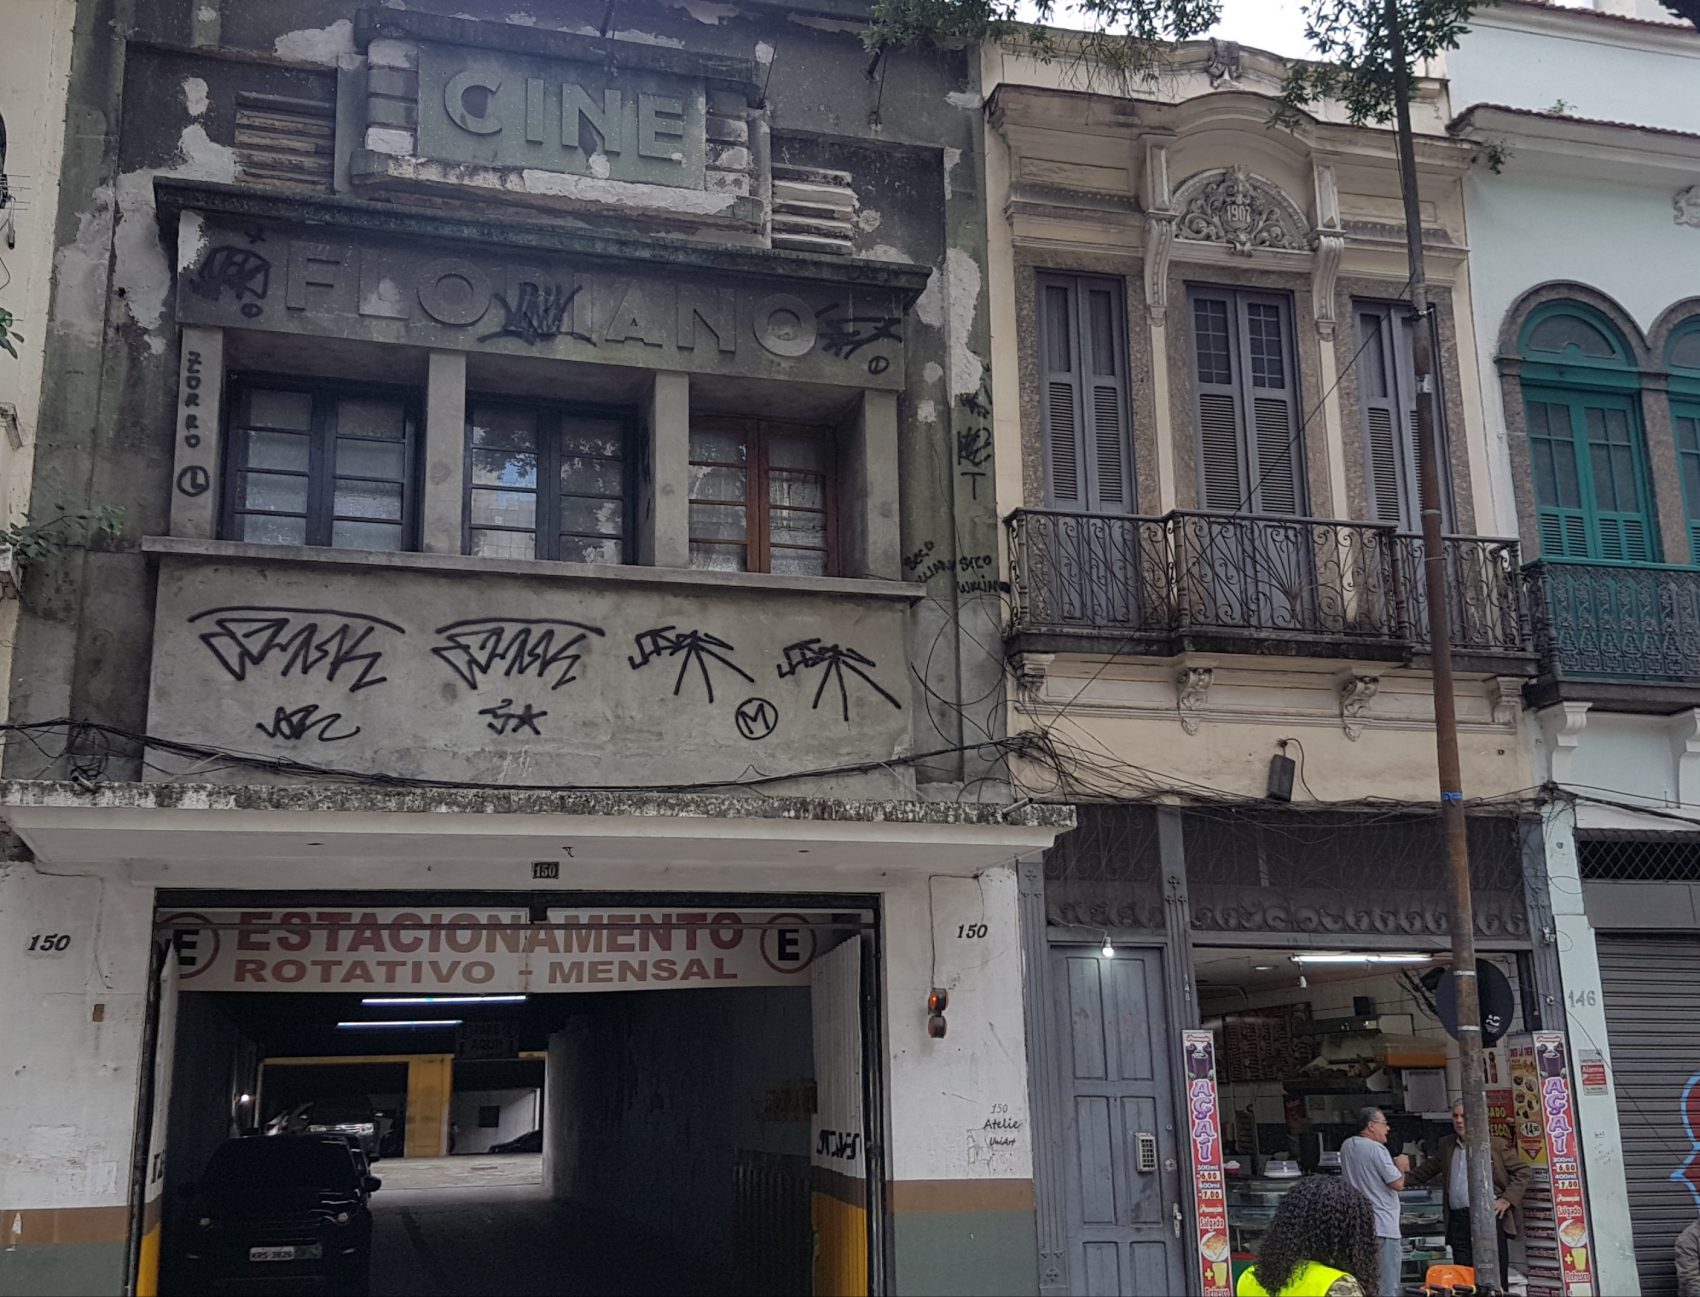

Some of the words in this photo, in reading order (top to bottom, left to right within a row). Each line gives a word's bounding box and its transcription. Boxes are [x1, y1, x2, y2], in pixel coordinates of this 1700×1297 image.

[444, 65, 686, 165] CINE
[287, 239, 818, 357] FLORIANO
[536, 863, 557, 878] 150
[237, 911, 743, 954] ESTACIONAMENTO
[956, 923, 988, 940] 150
[27, 934, 71, 952] 150
[778, 928, 800, 961] E
[234, 959, 495, 984] ROTATIVO
[548, 958, 738, 984] MENSAL
[1568, 989, 1596, 1008] 146
[990, 1103, 1009, 1114] 150
[1487, 1107, 1506, 1118] ADO
[1544, 1077, 1572, 1154] AÇAÍ
[983, 1118, 1023, 1130] Atelie
[1191, 1079, 1217, 1162] AÇAÍ
[1558, 1206, 1582, 1219] Salgado
[1200, 1217, 1225, 1231] Salgado
[1565, 1271, 1590, 1281] Refresco
